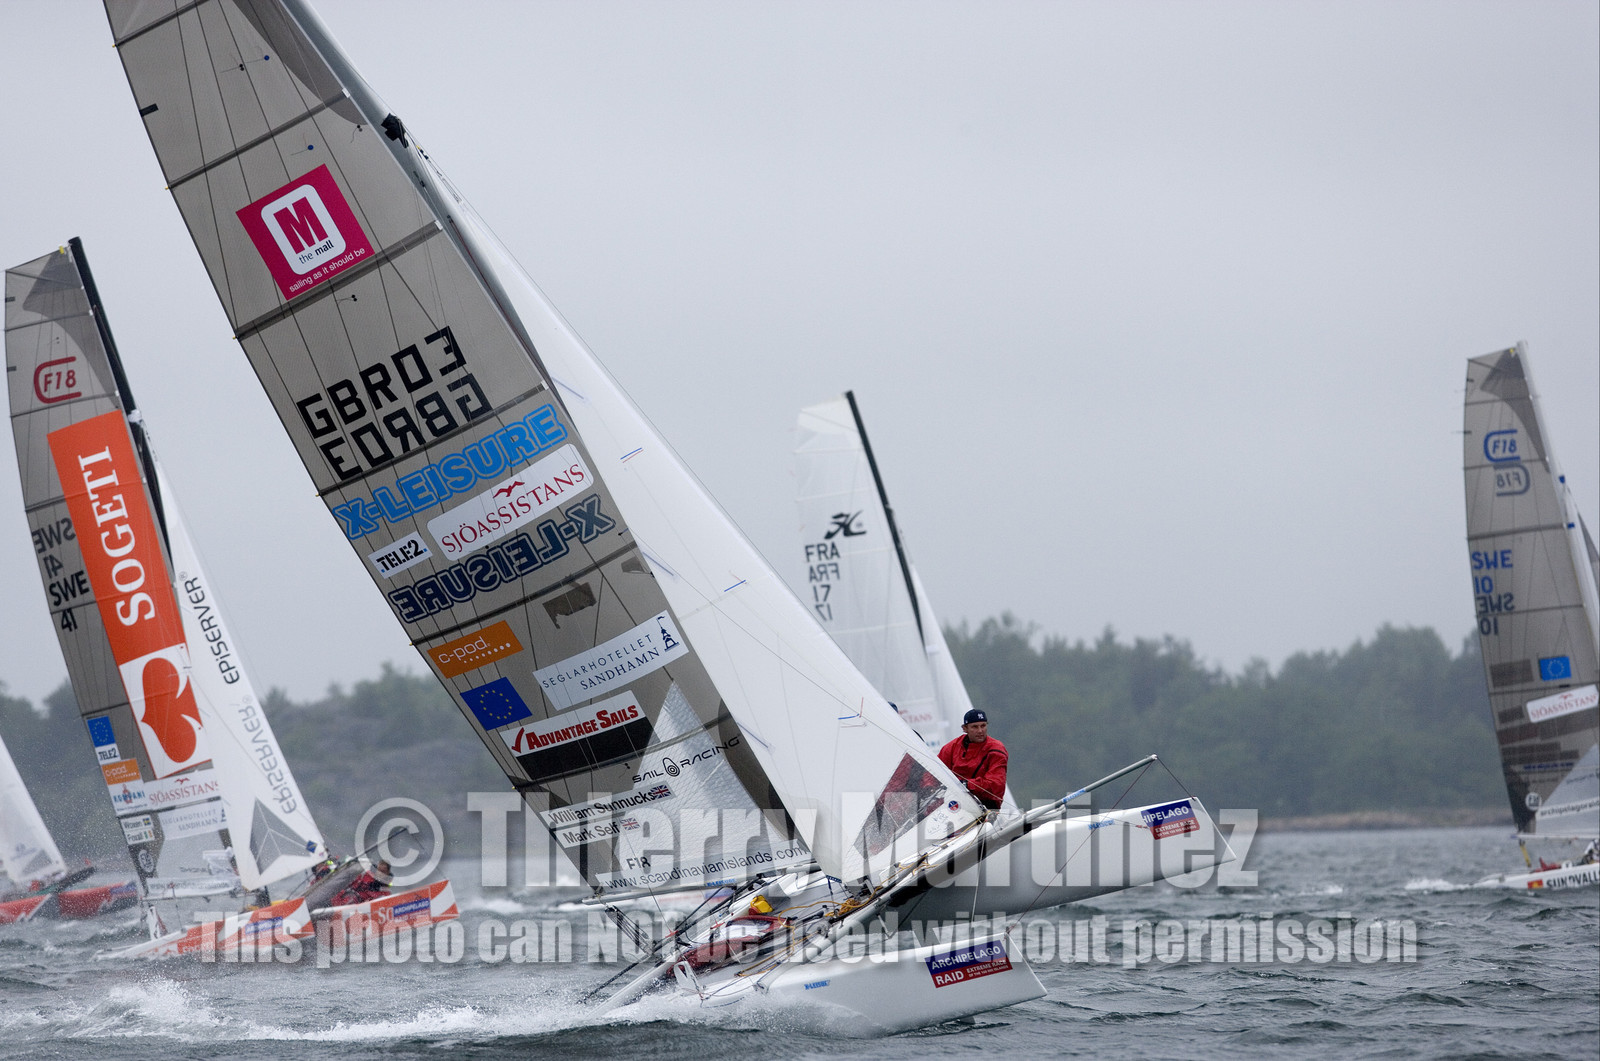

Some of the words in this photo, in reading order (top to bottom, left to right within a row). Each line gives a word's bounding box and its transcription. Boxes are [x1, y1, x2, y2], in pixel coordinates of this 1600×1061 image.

[273, 196, 329, 255] M
[299, 251, 314, 265] the
[314, 239, 334, 256] mall
[289, 275, 313, 293] sailing
[312, 270, 323, 280] as
[323, 266, 330, 275] it
[329, 253, 355, 272] should
[353, 246, 366, 261] be
[43, 369, 77, 393] F18
[1492, 438, 1517, 454] F18
[334, 404, 568, 540] X-LEISURE
[441, 464, 585, 553] SJÖASSISTANS
[78, 446, 155, 626] SOGETI
[805, 542, 841, 562] FRA
[1471, 549, 1513, 570] SWE
[49, 570, 90, 607] SWE
[813, 584, 831, 602] 17
[61, 608, 78, 632] 41
[438, 636, 488, 664] c-pod
[542, 634, 653, 689] SEGLARHOTELLET
[580, 647, 660, 690] SANDHAMN
[526, 718, 598, 752] ADVANTAGE
[597, 704, 639, 731] SAILS
[632, 769, 664, 784] SAIL
[680, 736, 742, 768] RACING
[548, 803, 596, 825] William
[594, 789, 656, 816] Sunnucks
[563, 826, 594, 844] Mark
[597, 821, 620, 838] Self
[604, 841, 808, 889] www.scandinavianislands.com
[626, 856, 651, 871] F18
[932, 945, 1001, 970] ARCHIPELAGO
[966, 961, 992, 974] EXTREME
[935, 971, 965, 985] RAID
